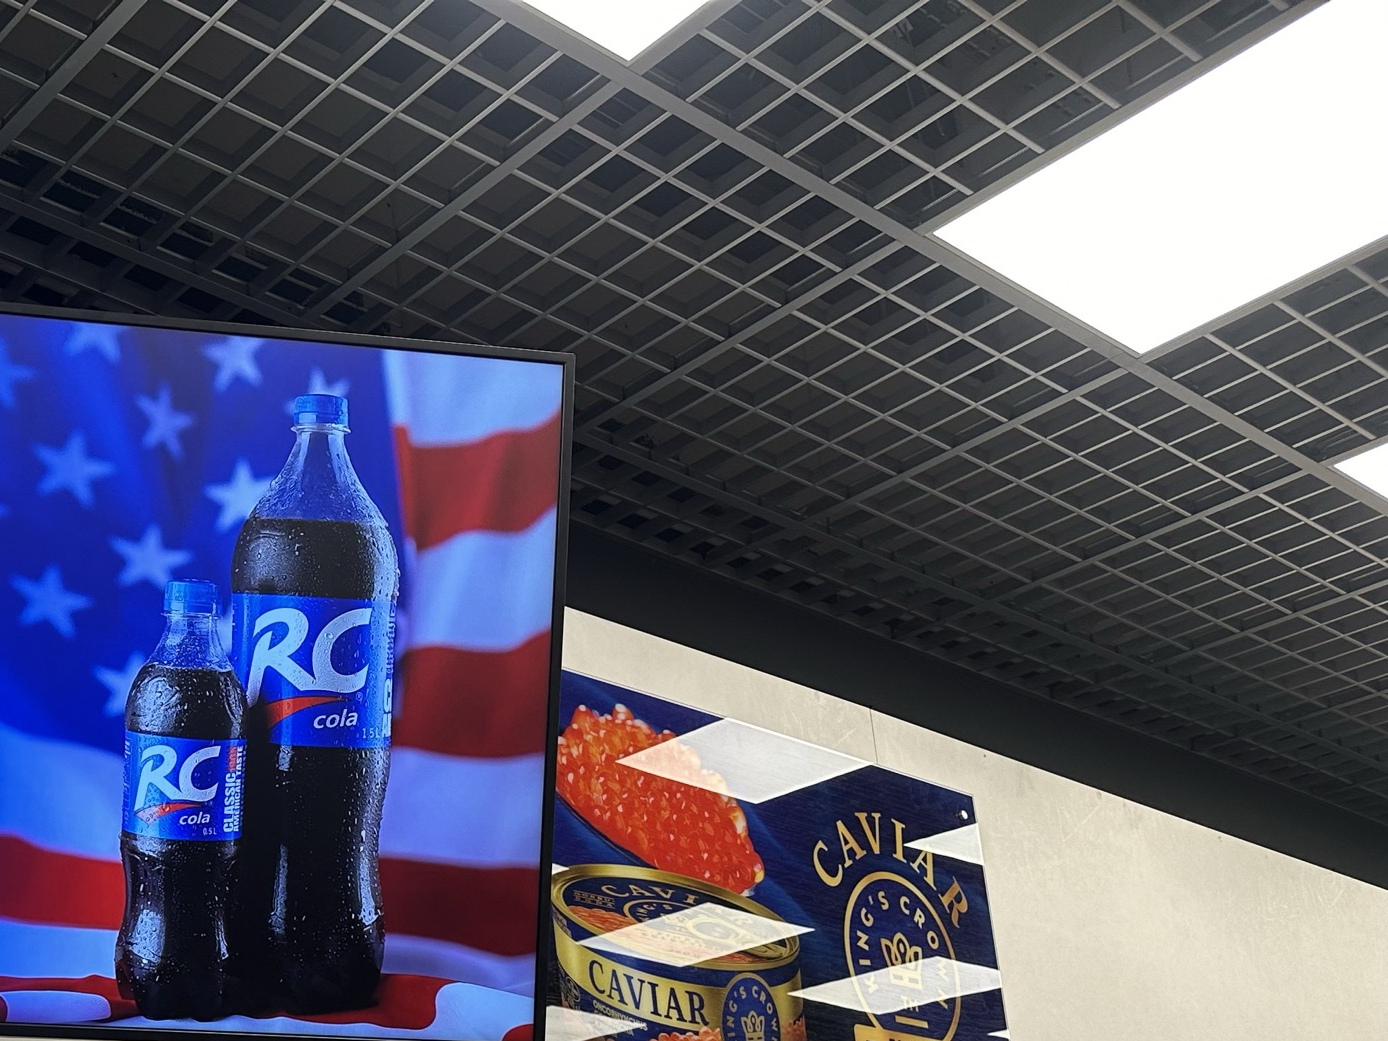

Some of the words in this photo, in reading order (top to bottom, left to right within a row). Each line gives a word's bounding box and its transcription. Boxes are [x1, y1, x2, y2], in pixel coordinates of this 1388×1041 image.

[247, 607, 372, 708] RC
[313, 709, 358, 729] cola
[133, 745, 222, 813] RC
[223, 772, 237, 832] CLASSIC
[178, 811, 211, 826] cola
[812, 811, 969, 929] CAVIAR
[857, 890, 890, 994] KING'S
[588, 959, 710, 1026] CAVIAR
